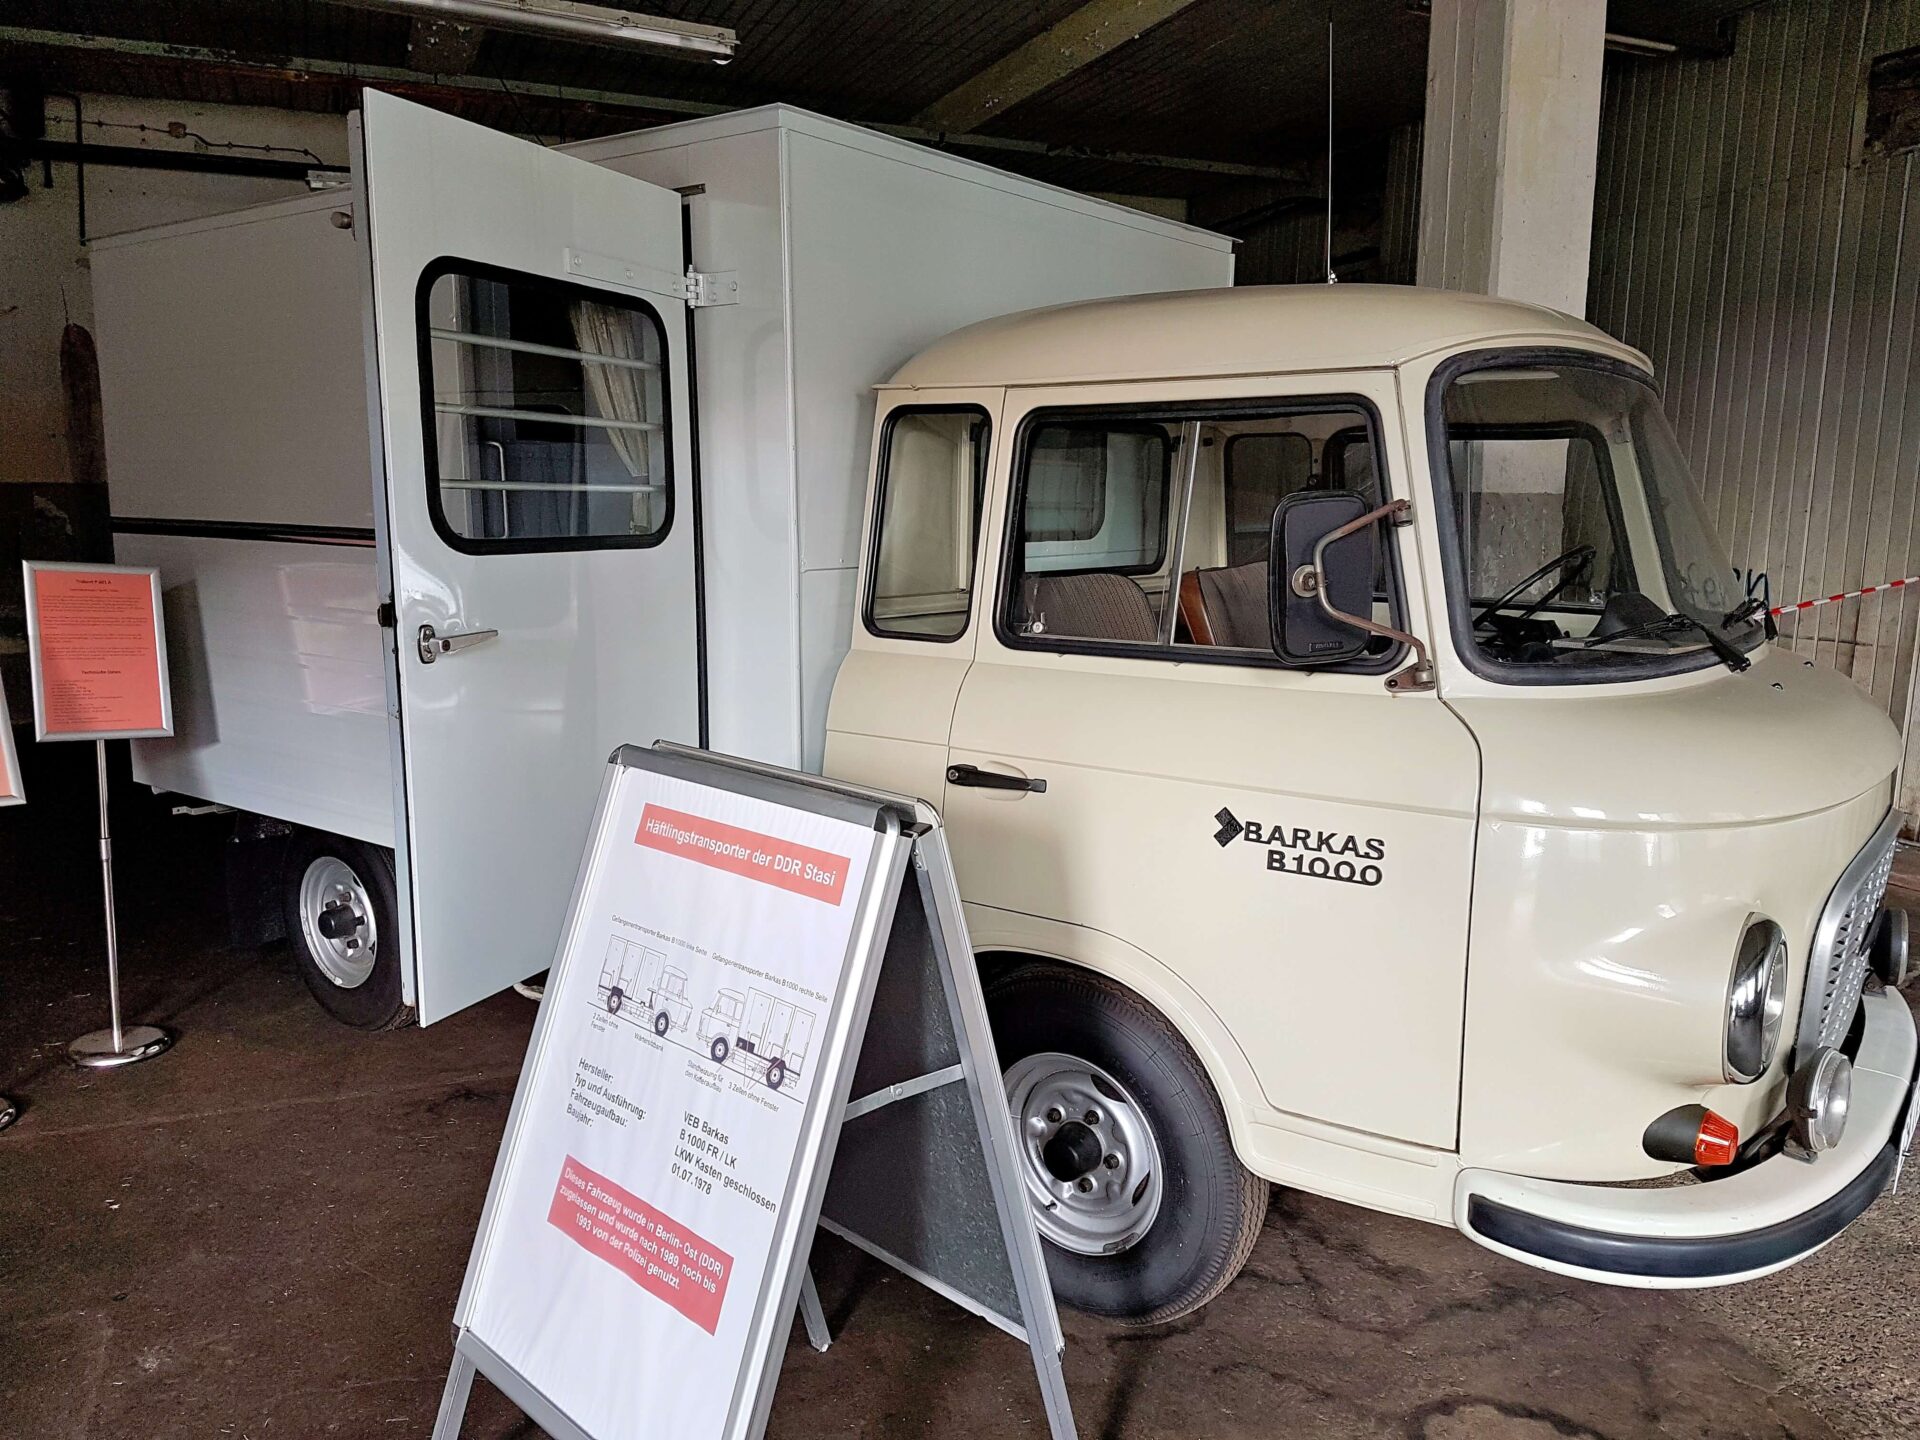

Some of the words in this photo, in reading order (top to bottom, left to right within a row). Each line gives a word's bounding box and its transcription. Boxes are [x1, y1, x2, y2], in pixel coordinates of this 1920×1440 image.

[645, 817, 750, 860] Häftlingstransporter
[752, 849, 772, 866] der
[774, 854, 801, 876] DDR
[804, 863, 836, 886] Stasi
[1244, 821, 1385, 861] BARKAS
[579, 1057, 613, 1084] Hersteller:
[567, 1103, 594, 1127] Baujahr:
[570, 1088, 628, 1127] Fahrzeugaufbau:
[575, 1073, 586, 1088] Typ
[587, 1081, 603, 1095] und
[602, 1088, 646, 1120] Ausführung:
[732, 1083, 747, 1097] Zellen
[748, 1091, 760, 1103] ohne
[760, 1097, 779, 1112] Fenster
[684, 1110, 699, 1128] VEB
[702, 1121, 729, 1144] Barkas
[680, 1129, 685, 1140] B
[687, 1133, 705, 1151] 1000
[706, 1144, 719, 1159] FR
[719, 1151, 724, 1161] /
[724, 1153, 737, 1169] LK
[675, 1145, 694, 1163] LKW
[695, 1156, 722, 1181] Kasten
[723, 1176, 776, 1213] geschlossen
[559, 1185, 596, 1216] zugelassen
[598, 1209, 614, 1225] und
[615, 1219, 638, 1241] wurde
[639, 1236, 657, 1255] nach
[660, 1247, 680, 1271] 1989,
[681, 1264, 701, 1283] noch
[702, 1276, 716, 1293] bis
[565, 1168, 586, 1190] Dieses
[586, 1184, 622, 1213] Fahrzeug
[623, 1205, 647, 1227] wurde
[647, 1219, 654, 1232] in
[656, 1224, 682, 1248] Berlin-
[683, 1242, 697, 1261] Ost
[698, 1252, 724, 1279] (DDR)
[575, 1213, 592, 1230] 1993
[592, 1225, 609, 1241] von
[609, 1234, 623, 1250] der
[623, 1242, 648, 1268] Polizei
[647, 1262, 680, 1289] genutzt.
